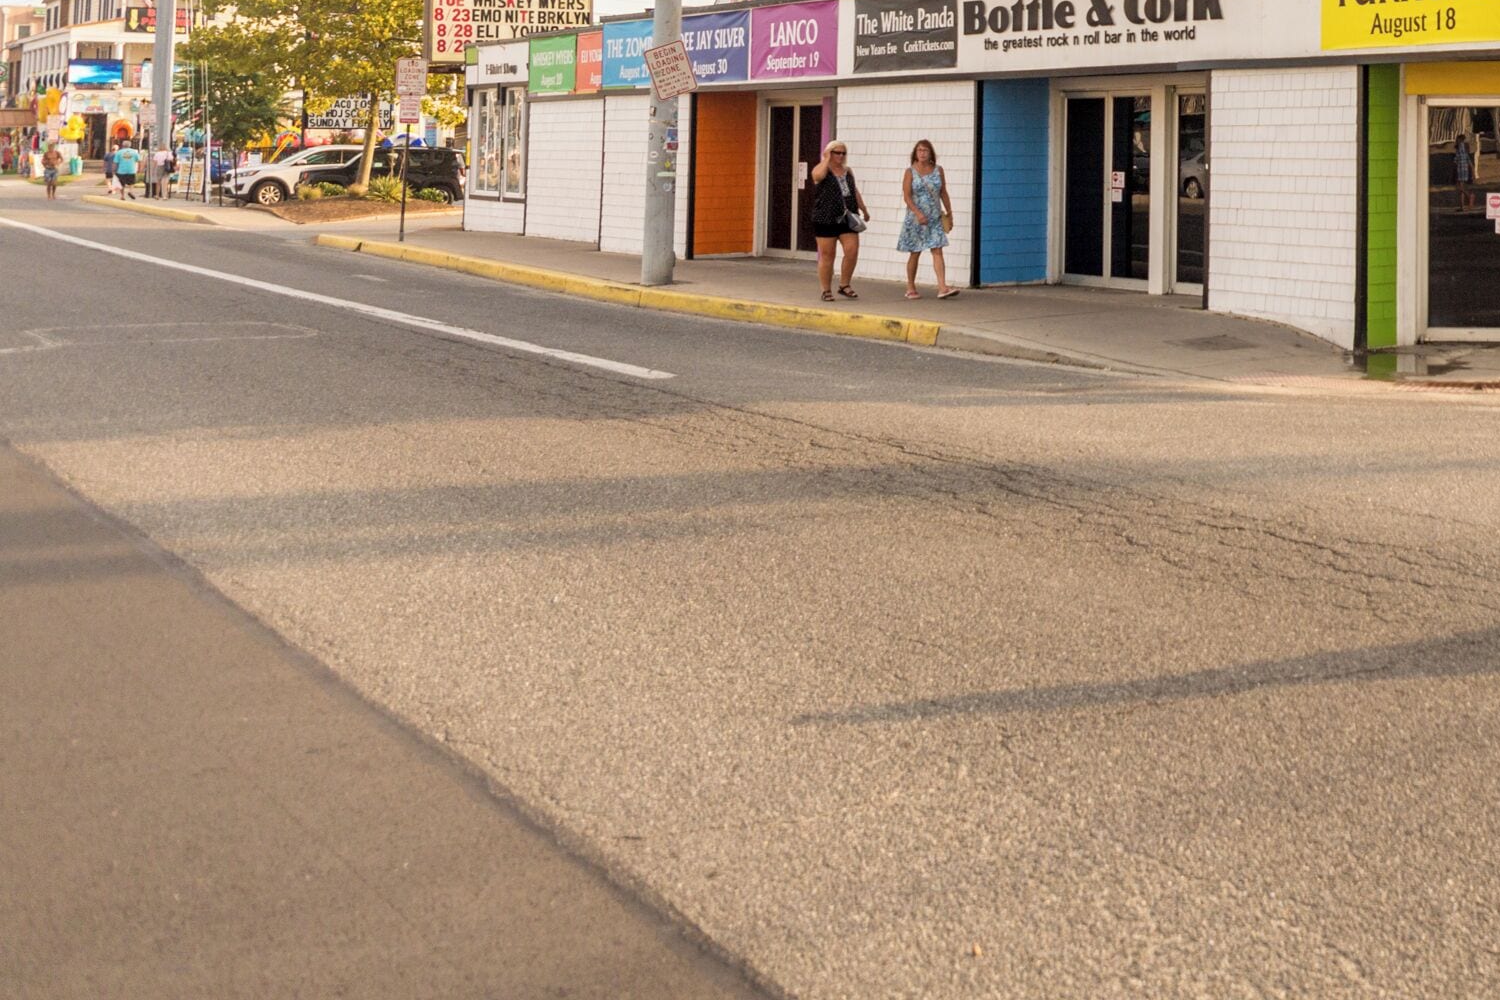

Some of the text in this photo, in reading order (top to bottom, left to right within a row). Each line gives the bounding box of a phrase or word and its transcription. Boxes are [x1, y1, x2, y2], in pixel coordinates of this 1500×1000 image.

[434, 8, 591, 25] 8/23 EMO NITE BRKLYN
[857, 5, 955, 36] The White Panda
[1370, 7, 1456, 38] August 18
[437, 24, 473, 38] 8/28
[476, 25, 499, 39] ELI
[696, 30, 714, 51] JAY
[714, 27, 745, 48] SILVER
[769, 18, 819, 48] LANCO
[984, 26, 1197, 52] the greatest rock n roll bar in the world
[607, 38, 624, 59] THE
[653, 46, 677, 60] BEGIN
[856, 40, 955, 57] New Years Eve CorkTickets.com
[651, 52, 685, 70] LOADING
[661, 64, 681, 76] ZONE
[692, 58, 728, 78] August 30
[766, 51, 820, 73] September 19
[619, 64, 641, 81] August
[309, 119, 347, 128] SUNDAY
